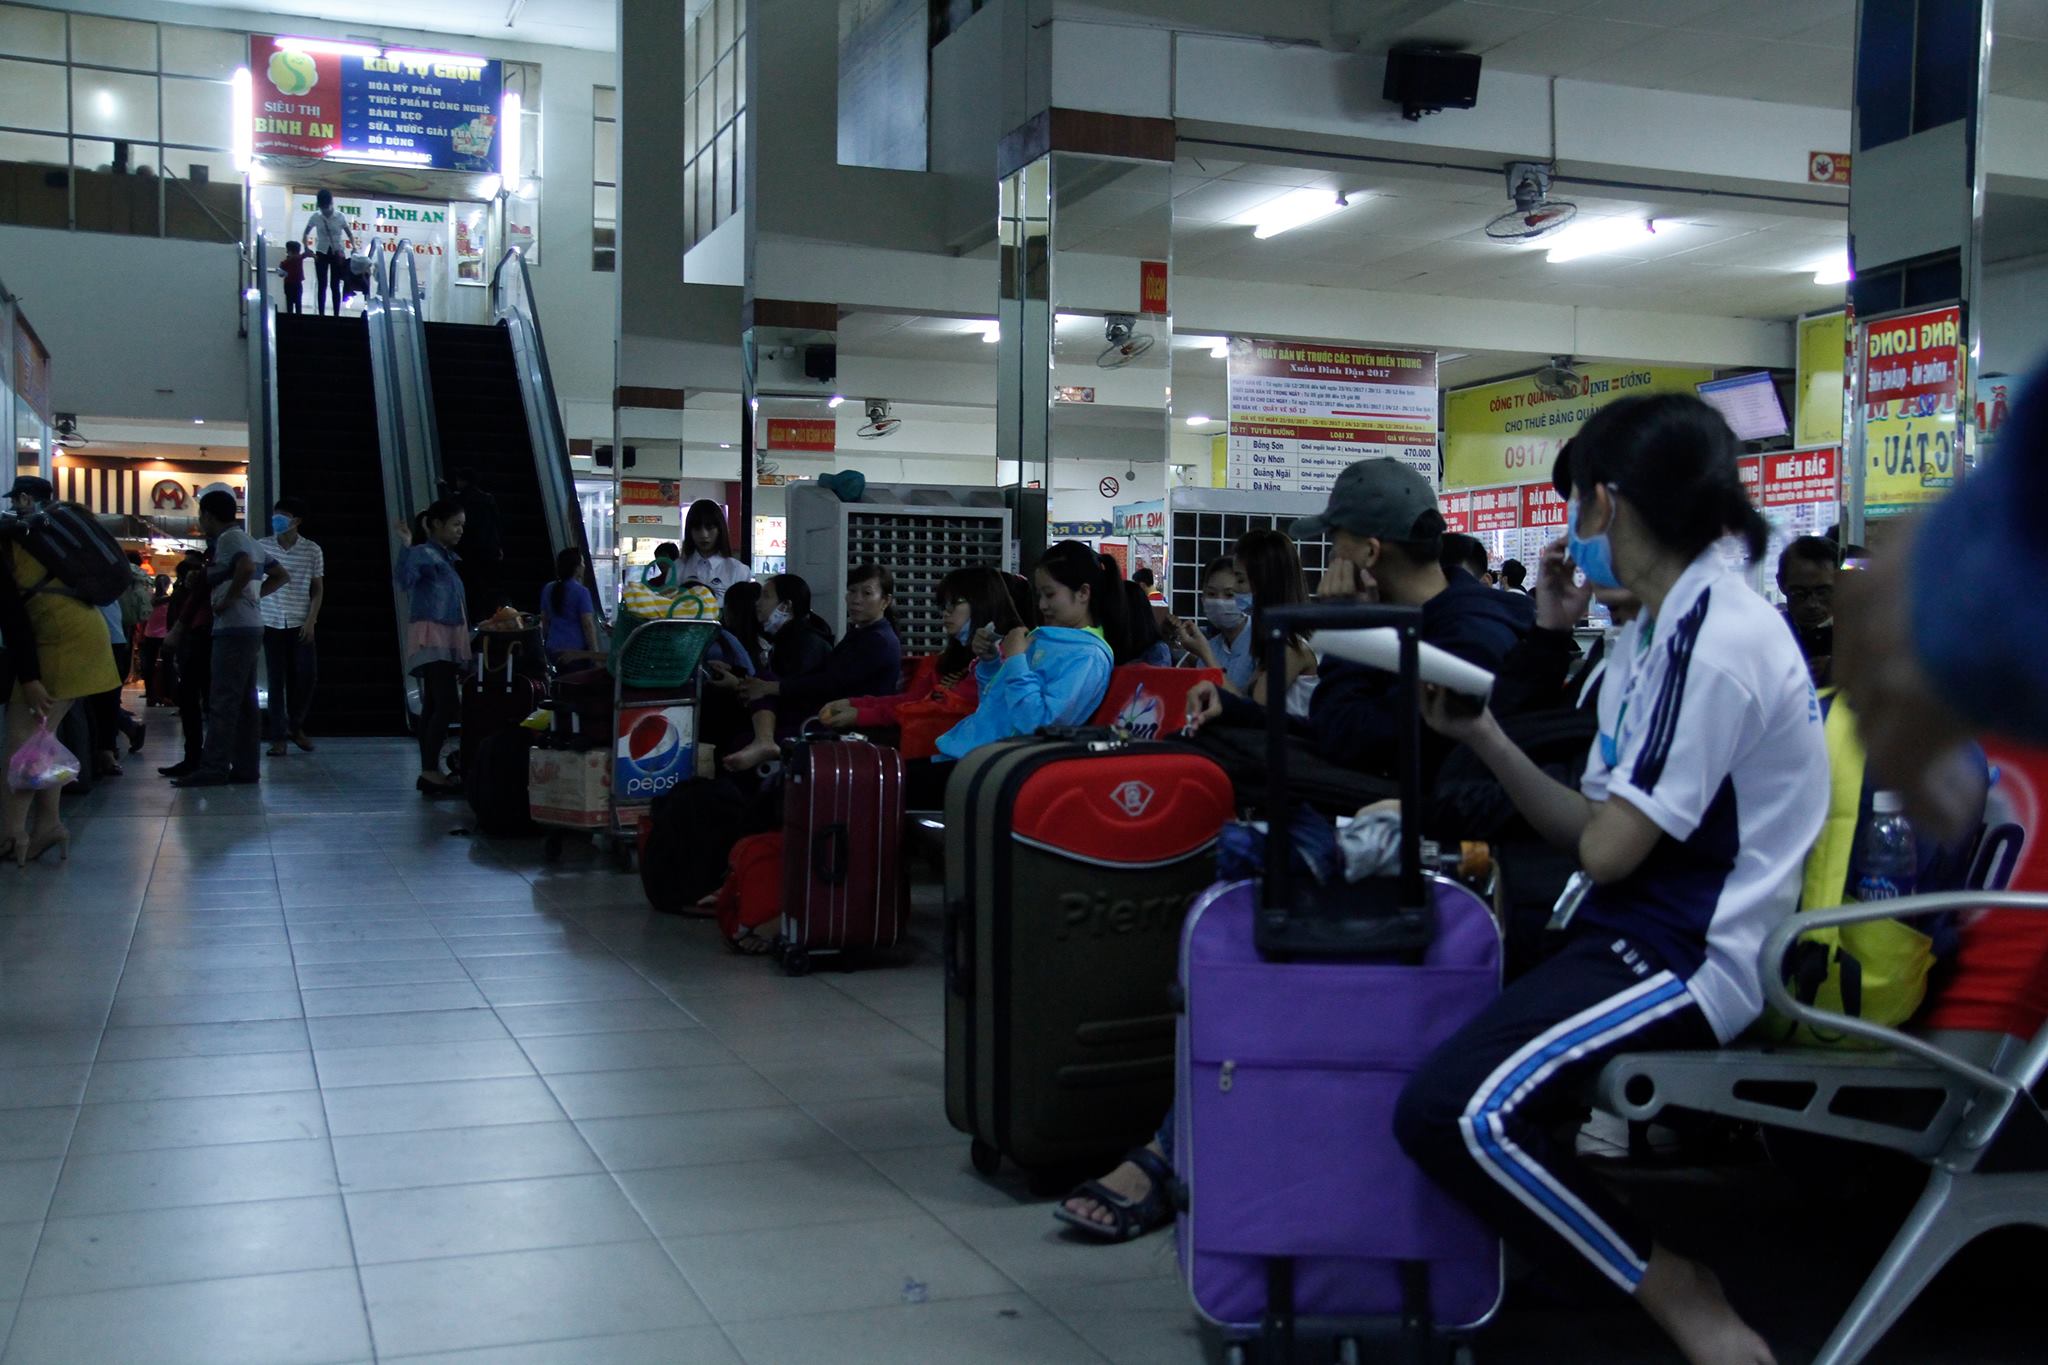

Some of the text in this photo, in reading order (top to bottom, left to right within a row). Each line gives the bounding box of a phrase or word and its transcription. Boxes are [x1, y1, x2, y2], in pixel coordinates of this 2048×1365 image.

[264, 100, 321, 118] SIÊU THỊ
[256, 115, 334, 139] BÌNH AN
[376, 205, 416, 222] BÌNH
[420, 211, 444, 224] AN
[374, 223, 399, 236] THỊ
[414, 243, 444, 256] GÀY
[1278, 347, 1296, 361] BÁN
[1296, 349, 1306, 361] VÉ
[1334, 352, 1350, 364] CÁC
[1351, 353, 1375, 367] TUYẾN
[1376, 355, 1396, 368] MIỀN
[1397, 357, 1422, 369] TRUNG
[1290, 363, 1316, 373] Xuân
[1367, 369, 1391, 378] 2017
[1490, 396, 1512, 412] CÔNG
[1515, 394, 1525, 409] TY
[1505, 420, 1522, 432] CHO
[1525, 412, 1546, 428] THUÊ
[1549, 409, 1574, 426] BẢNG
[1251, 426, 1271, 435] TUYẾN
[1271, 441, 1283, 449] Sơn
[1404, 448, 1432, 459] 470.000
[1505, 440, 1548, 469] 0917
[1253, 454, 1266, 464] Quy
[1267, 455, 1285, 463] Nhơn
[1404, 462, 1432, 472] 0.000
[1776, 452, 1826, 480] MIỀN BẮC
[1253, 467, 1274, 478] Quảng
[627, 771, 679, 795] pepsi
[1057, 888, 1196, 940] Pierr
